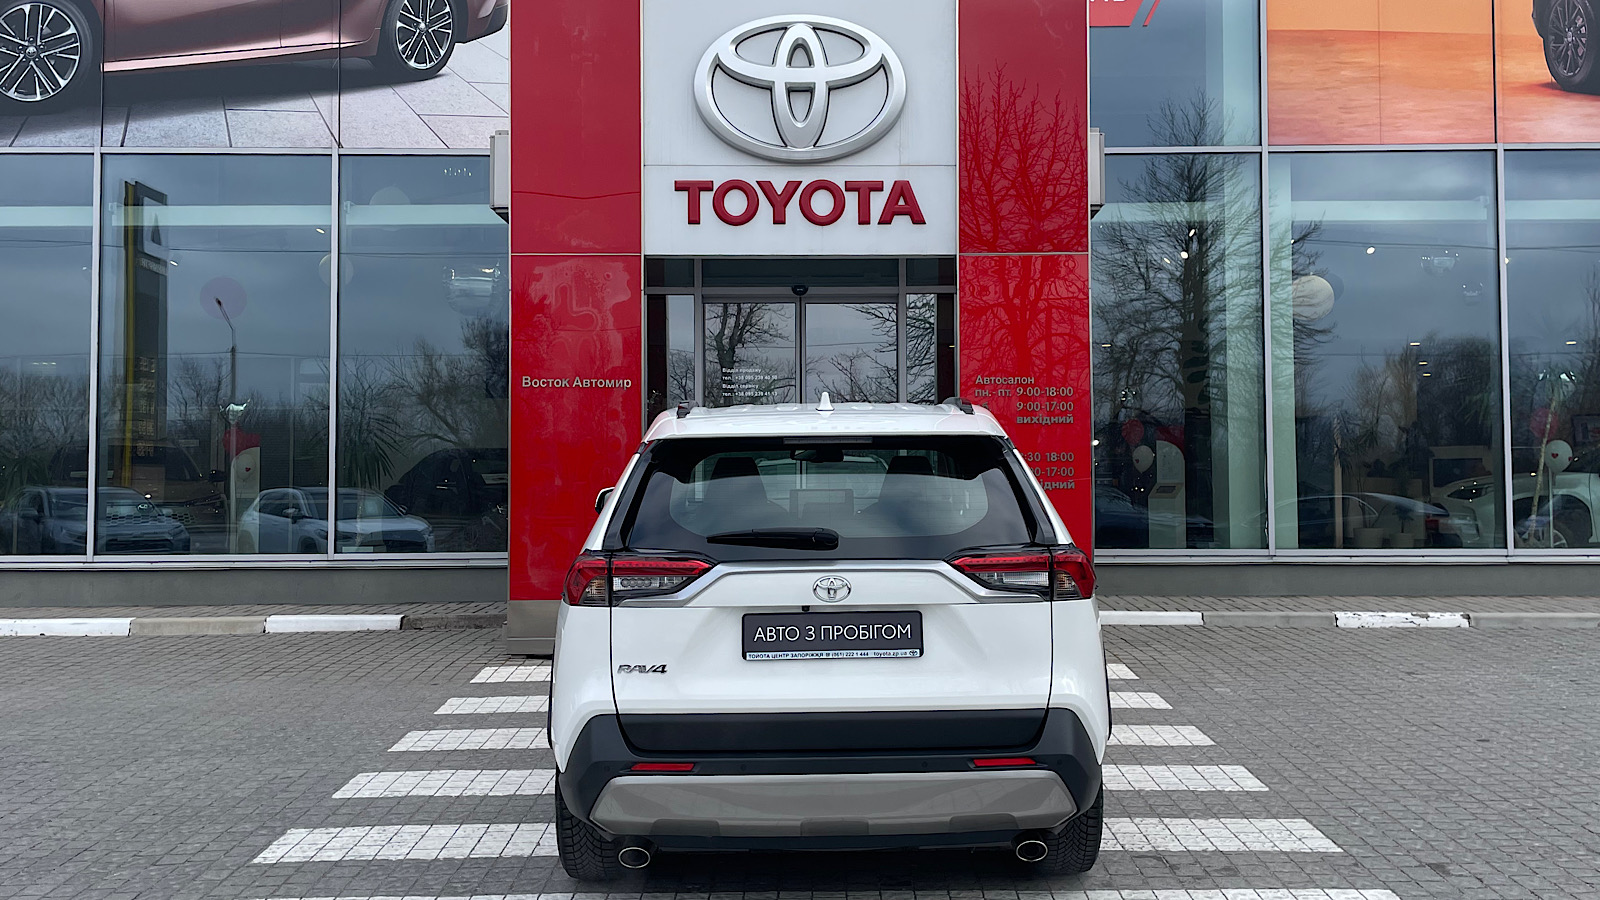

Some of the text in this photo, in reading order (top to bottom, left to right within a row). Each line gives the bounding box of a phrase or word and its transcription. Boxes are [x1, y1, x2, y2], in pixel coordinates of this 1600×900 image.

[674, 179, 926, 226] TOYOTA
[522, 376, 632, 390] Восток Автомир
[975, 374, 1035, 385] Автосалон
[1016, 402, 1074, 412] 9:00-17:00
[1016, 413, 1074, 426] вихідний
[1046, 452, 1075, 462] 18:00
[1031, 467, 1075, 477] 0-17:00
[754, 624, 911, 642] АВТО З ПРОБІГОМ
[617, 664, 668, 674] RAV4
